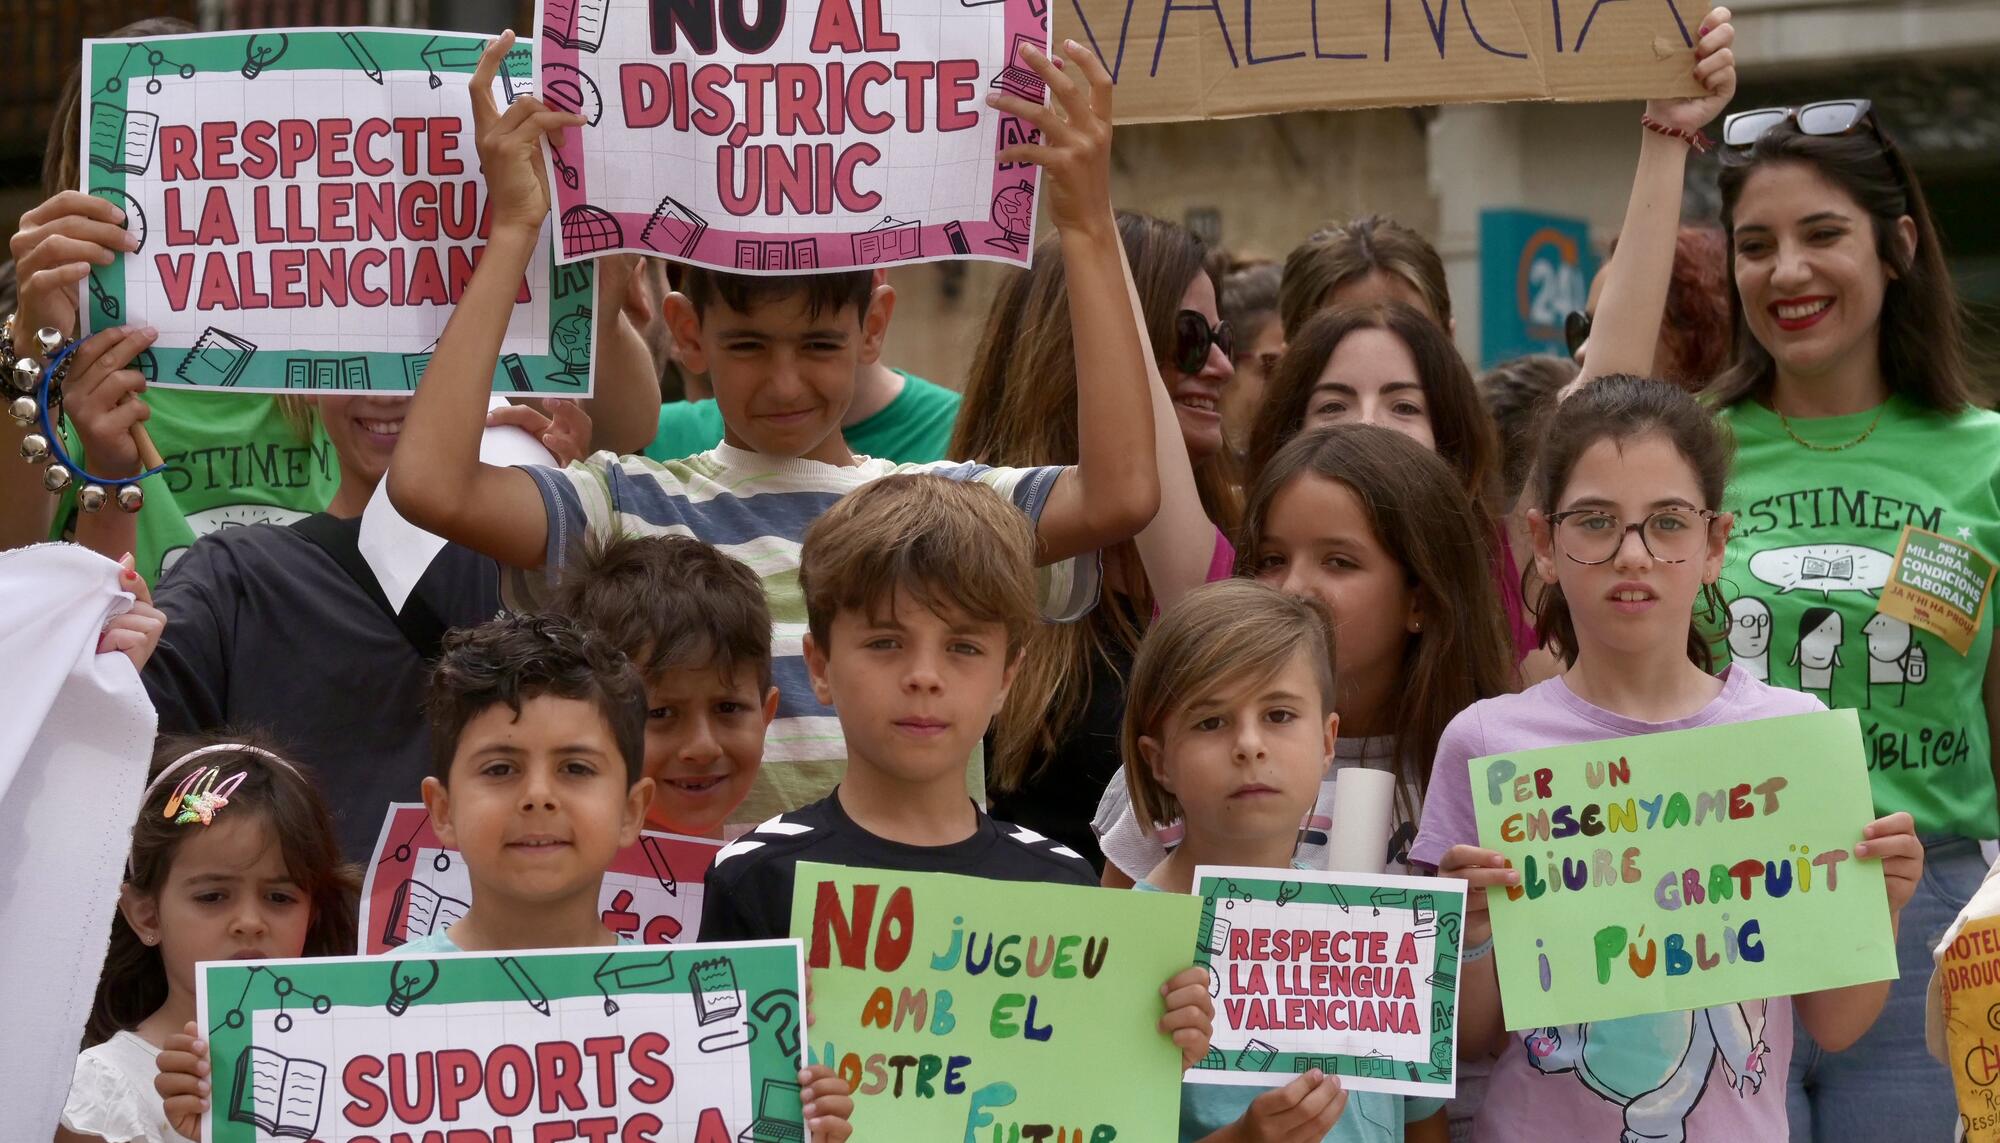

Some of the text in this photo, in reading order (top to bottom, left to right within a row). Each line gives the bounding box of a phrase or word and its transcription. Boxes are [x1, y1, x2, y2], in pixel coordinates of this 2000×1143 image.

[649, 0, 900, 55] NO AL
[619, 59, 979, 136] DISTRICTE
[158, 117, 464, 182] RESPECTE
[716, 122, 882, 216] ÚNIC
[164, 180, 494, 246] LA LLENGU
[154, 246, 532, 312] VALENCIAN
[163, 439, 332, 492] STIMEM
[1906, 543, 1962, 572] MILLORA
[1938, 542, 1969, 561] PER LA
[1902, 557, 1981, 603] CONDICIONS
[1902, 571, 1975, 615] LABORALS
[1486, 756, 1631, 806] PER UN
[1501, 776, 1788, 842] ENSENYAMET
[809, 880, 914, 973] NO
[1229, 928, 1419, 965] RESPECTE A
[1229, 964, 1416, 999] LA LLENGUA
[861, 986, 1053, 1042] AMB EL
[1223, 998, 1421, 1034] VALENCIANA
[342, 1032, 674, 1128] SUPORTS
